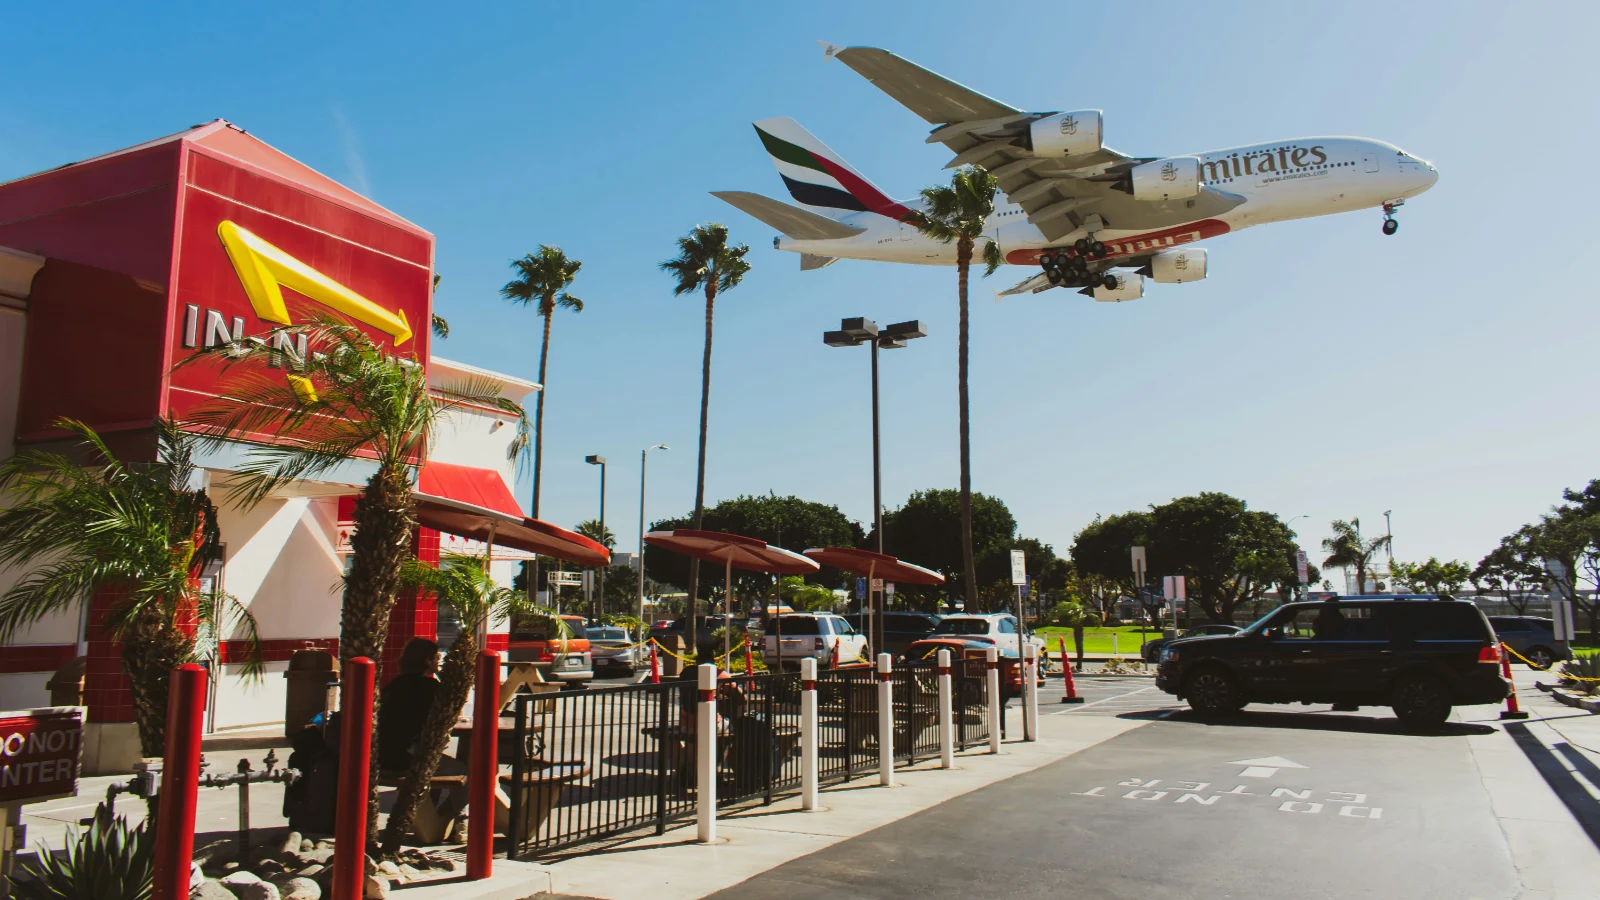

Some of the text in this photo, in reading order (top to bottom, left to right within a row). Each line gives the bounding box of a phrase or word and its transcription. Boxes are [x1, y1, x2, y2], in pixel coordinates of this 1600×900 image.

[1199, 145, 1327, 182] mirates
[1261, 169, 1328, 184] www.emirates.com
[0, 729, 80, 756] O NOT
[0, 758, 73, 787] NTER
[1070, 786, 1383, 819] DO NOT
[1117, 777, 1367, 803] ENTER
